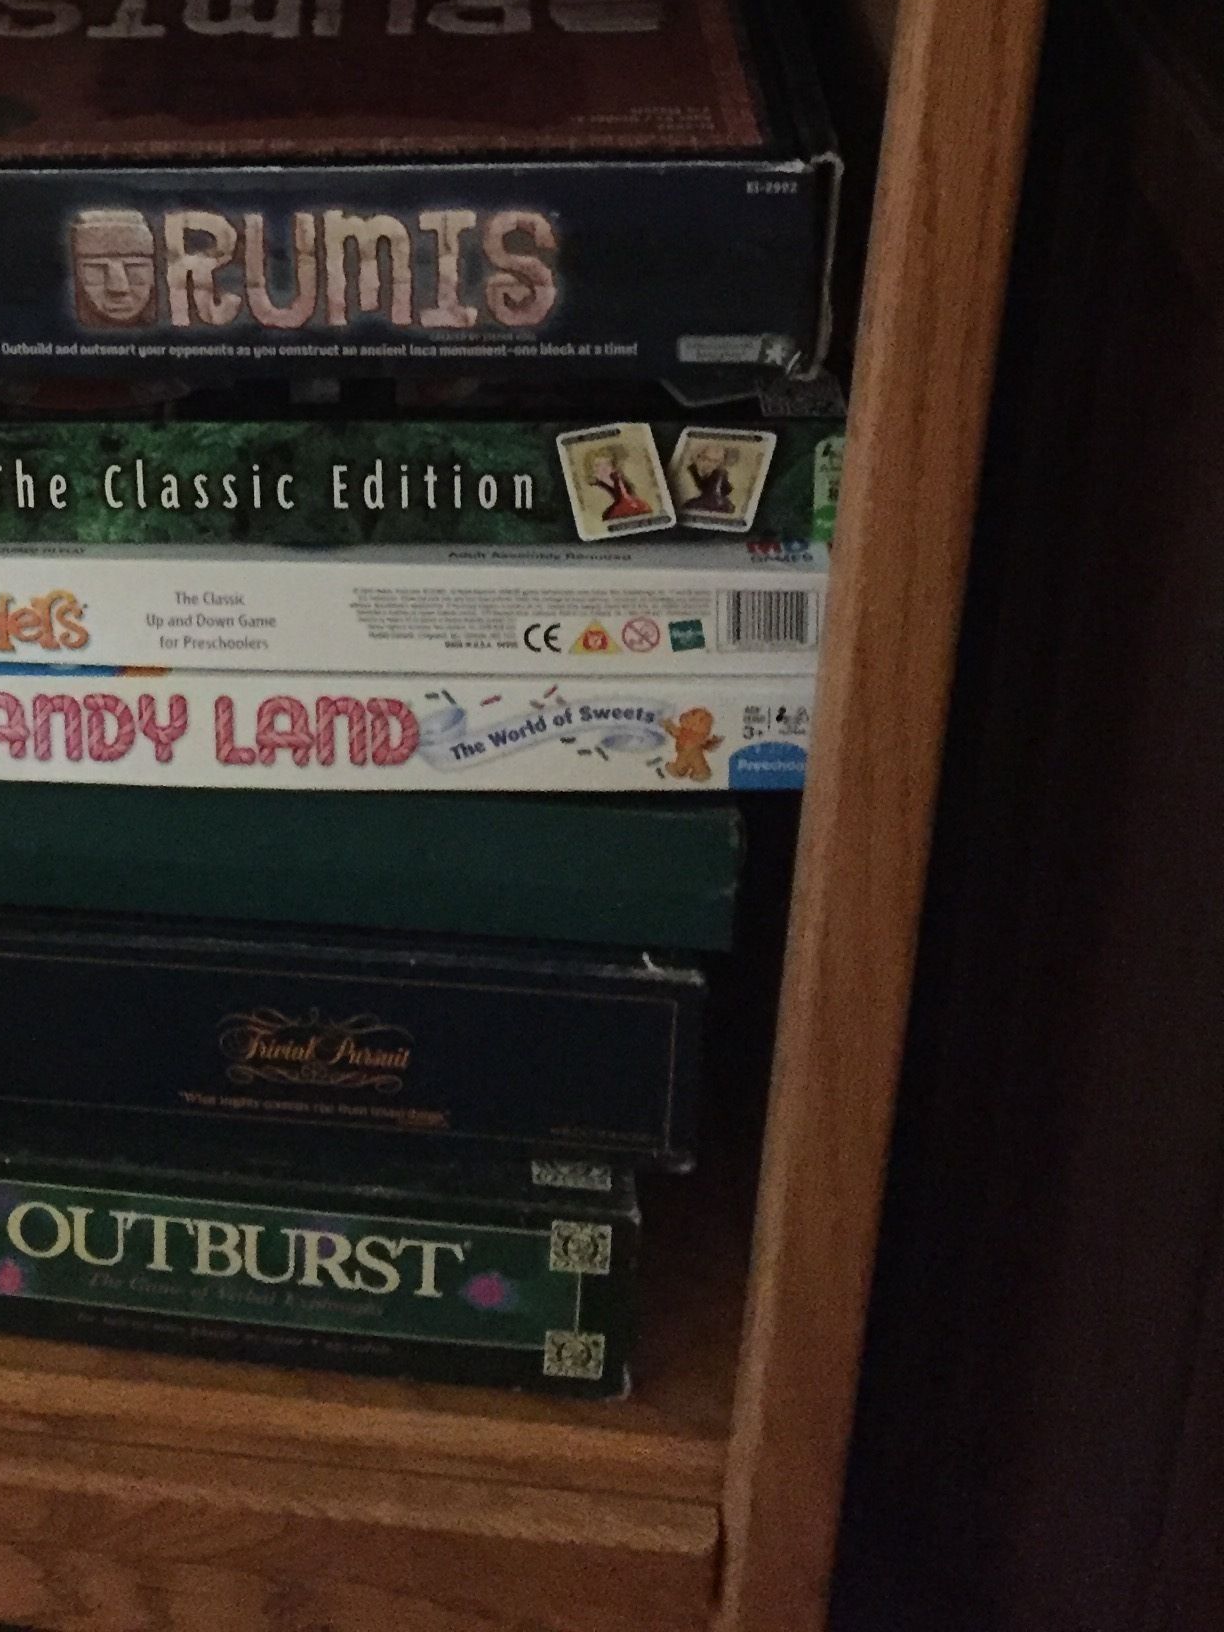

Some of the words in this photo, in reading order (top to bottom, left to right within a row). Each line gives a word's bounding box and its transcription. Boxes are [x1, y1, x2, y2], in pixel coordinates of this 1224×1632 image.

[162, 208, 560, 329] RUMIS
[1, 341, 52, 356] Outbuild
[55, 341, 77, 356] and
[80, 341, 137, 356] outsmart
[138, 344, 167, 360] your
[169, 343, 235, 360] opponents
[236, 345, 251, 356] as
[253, 345, 276, 360] you
[279, 343, 340, 357] construct
[342, 346, 358, 357] an
[360, 342, 407, 357] ancient
[409, 342, 437, 357] Inca
[539, 342, 576, 357] block
[578, 343, 592, 357] at
[604, 342, 639, 357] time!
[104, 459, 295, 511] Classic
[332, 459, 533, 511] Edition
[175, 590, 199, 606] The
[203, 590, 245, 606] Classic
[146, 614, 166, 630] Up
[167, 614, 194, 628] and
[196, 614, 235, 629] Down
[238, 615, 278, 629] Game
[159, 634, 180, 649] for
[183, 635, 270, 651] Preschoolers
[213, 694, 421, 767] LAND
[450, 738, 486, 761] The
[487, 718, 549, 749] World
[552, 705, 574, 728] of
[578, 704, 656, 725] Sweets
[742, 725, 765, 740] 3+
[245, 1032, 317, 1062] Trivial
[328, 1036, 411, 1069] Pursuit
[5, 1201, 464, 1299] OUTBURST
